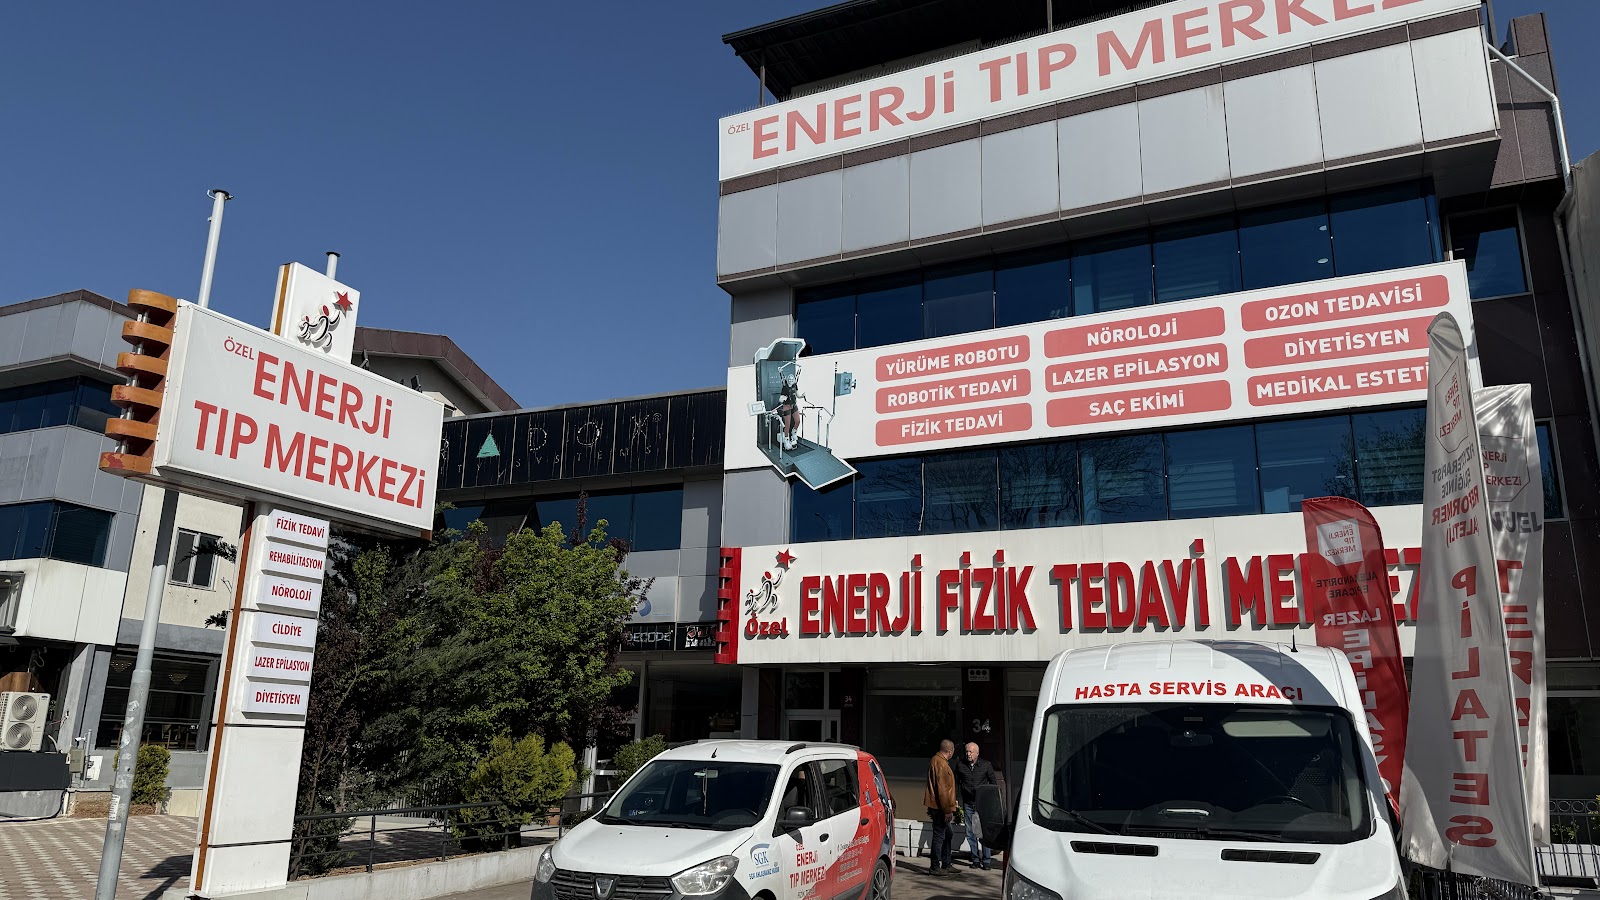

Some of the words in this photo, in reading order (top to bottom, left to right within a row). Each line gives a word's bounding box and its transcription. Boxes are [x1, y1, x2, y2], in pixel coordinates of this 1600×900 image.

[727, 121, 750, 136] ÖZEL
[978, 42, 1077, 104] TIP
[1097, 0, 1424, 77] MERK
[1265, 301, 1319, 322] OZON
[1323, 283, 1423, 314] TEDAVİSİ
[1086, 317, 1178, 347] NÖROLOJİ
[1284, 328, 1410, 358] DİYETİSYEN
[224, 336, 254, 361] ÖZEL
[885, 350, 951, 376] YÜRÜME
[954, 344, 1020, 367] ROBOTU
[1051, 365, 1110, 387] LAZER
[1113, 351, 1221, 379] EPİLASYON
[253, 351, 393, 439] ENERJi
[887, 384, 956, 408] ROBOTİK
[959, 375, 1018, 398] TEDAVİ
[1256, 375, 1353, 399] MEDİKAL
[1089, 399, 1126, 418] SAÇ
[1129, 389, 1185, 413] EKİMİ
[901, 418, 942, 438] FİZİK
[944, 409, 1003, 432] TEDAVİ
[194, 400, 258, 460] TIP
[263, 424, 426, 509] MERKEZi
[1481, 451, 1508, 463] NERJi
[1486, 475, 1522, 486] ERKEZi
[276, 518, 297, 533] FİZİK
[298, 521, 325, 539] TEDAVİ
[269, 550, 323, 570] REHABİLİTASYON
[271, 584, 312, 601] NÖROLOJİ
[800, 554, 923, 636] ENERJİ
[937, 549, 1037, 634] FİZİK
[1051, 539, 1211, 629] TEDAVİ
[272, 622, 302, 637] CİLDİYE
[744, 612, 789, 637] Özel
[254, 656, 274, 669] LAZER
[276, 656, 310, 672] EPİLASYON
[255, 690, 301, 705] DİYETİSYEN
[1075, 683, 1142, 700] HASTA
[1149, 679, 1228, 698] SERVİS
[1234, 682, 1303, 702] ARACI
[972, 718, 991, 733] 34
[754, 851, 769, 866] SGK
[790, 873, 800, 888] TIP
